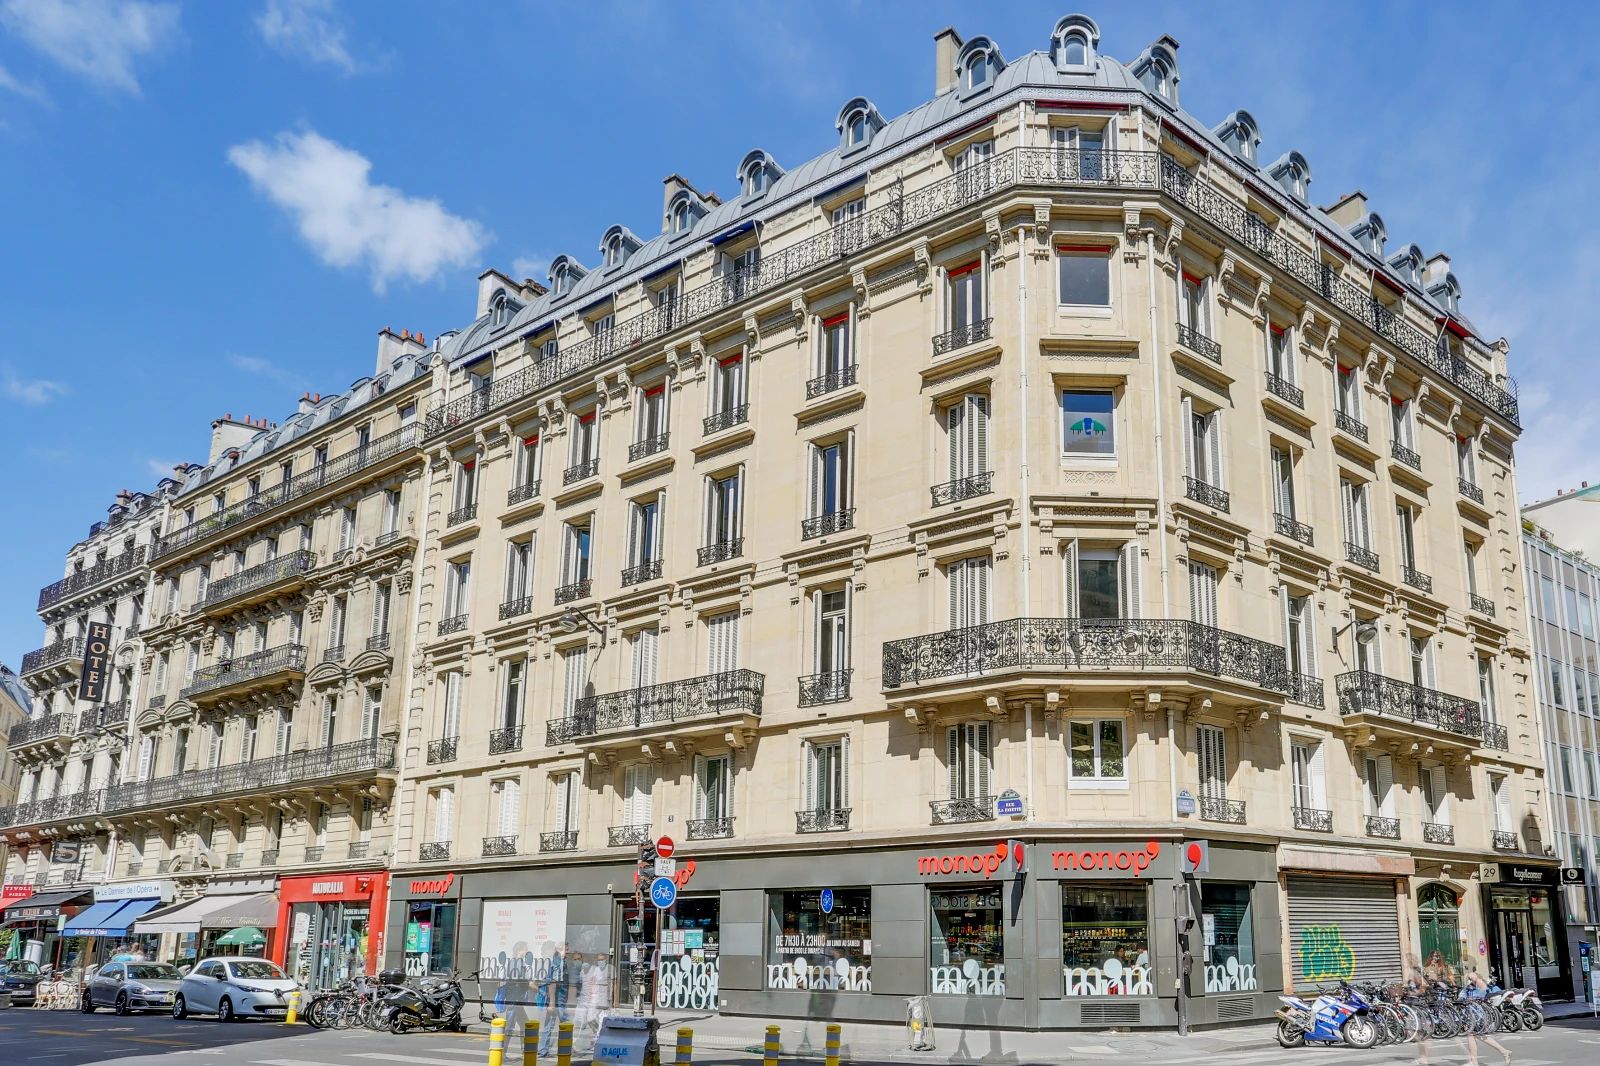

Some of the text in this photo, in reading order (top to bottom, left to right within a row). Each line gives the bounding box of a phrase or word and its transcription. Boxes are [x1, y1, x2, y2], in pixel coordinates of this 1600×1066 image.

[86, 625, 108, 698] HOTEL
[1483, 868, 1496, 878] 29
[312, 881, 344, 894] NATURALIA
[776, 935, 783, 946] DE
[784, 935, 800, 946] 7H30
[800, 932, 805, 946] À
[806, 934, 826, 947] 23H00
[1316, 1014, 1340, 1027] SUZUKI
